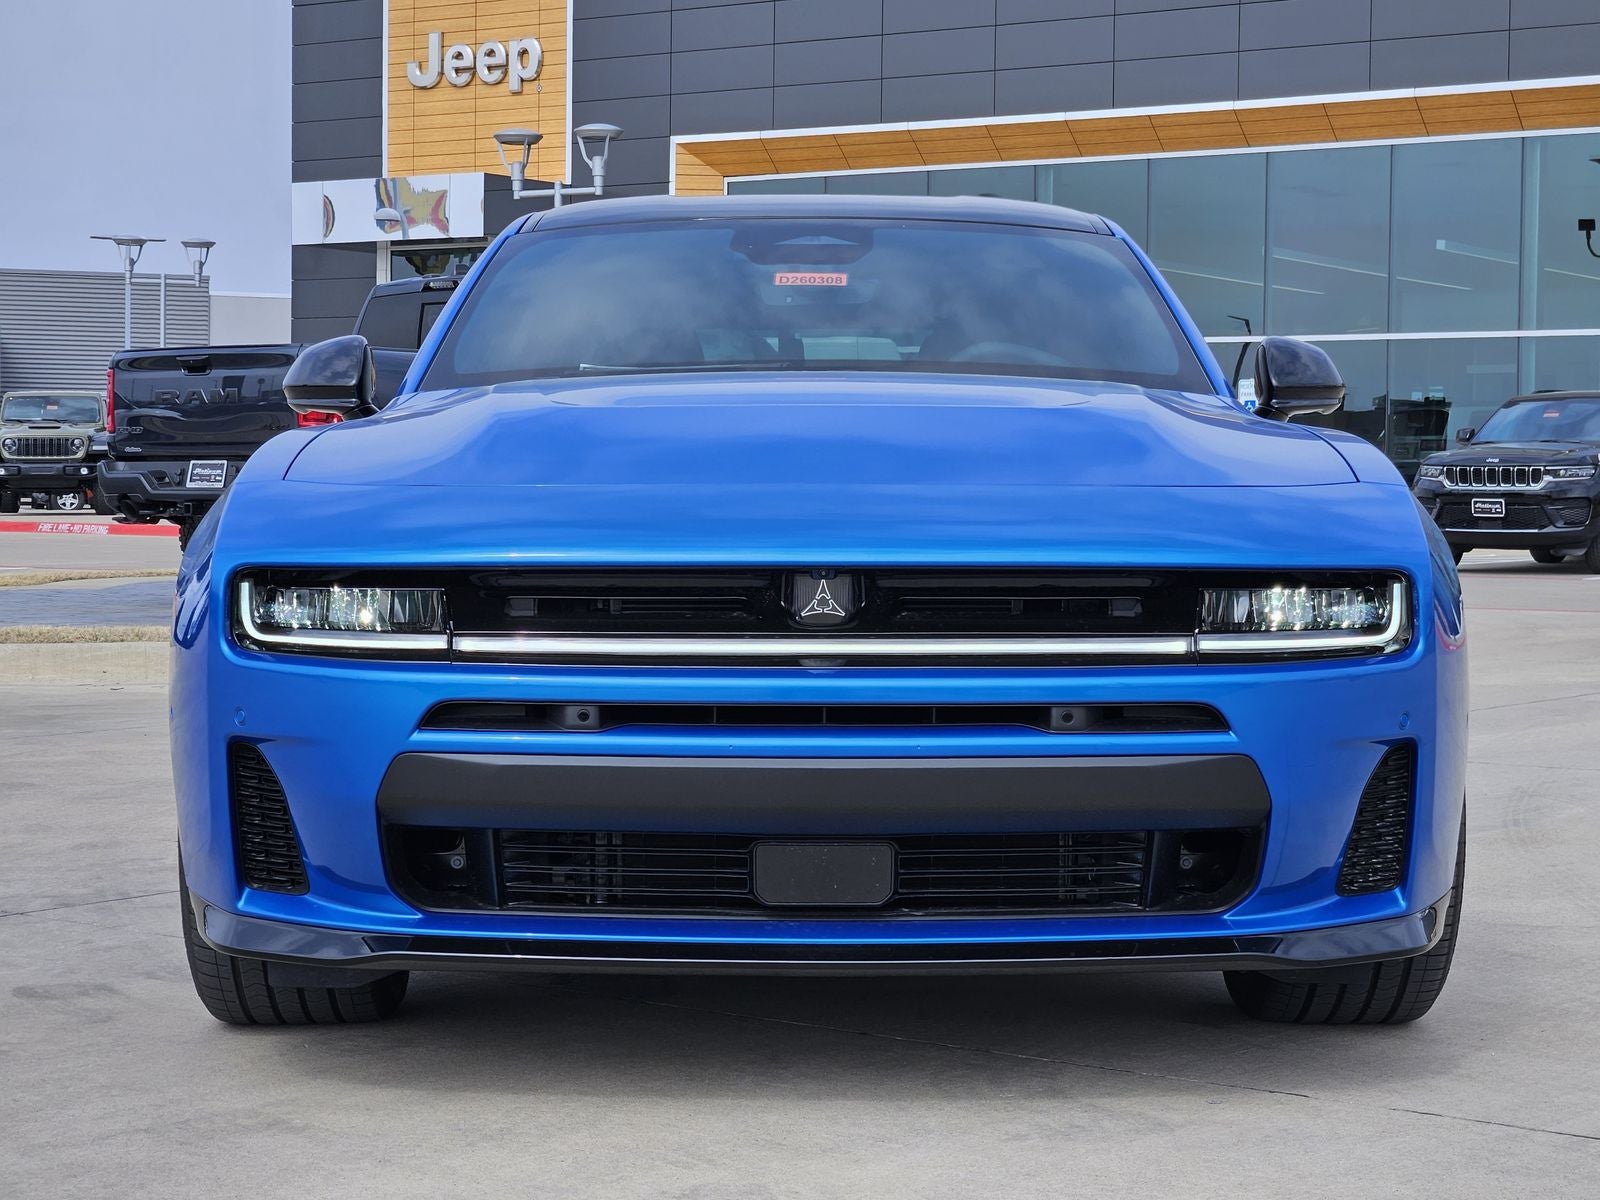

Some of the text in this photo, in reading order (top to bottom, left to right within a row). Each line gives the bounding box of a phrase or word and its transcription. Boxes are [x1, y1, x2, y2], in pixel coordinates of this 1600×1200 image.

[406, 31, 543, 94] Jeep
[779, 275, 843, 285] D260308
[154, 387, 239, 405] RAM
[37, 523, 54, 532] FIRE
[53, 523, 71, 533] LANE
[82, 524, 109, 535] PARKING
